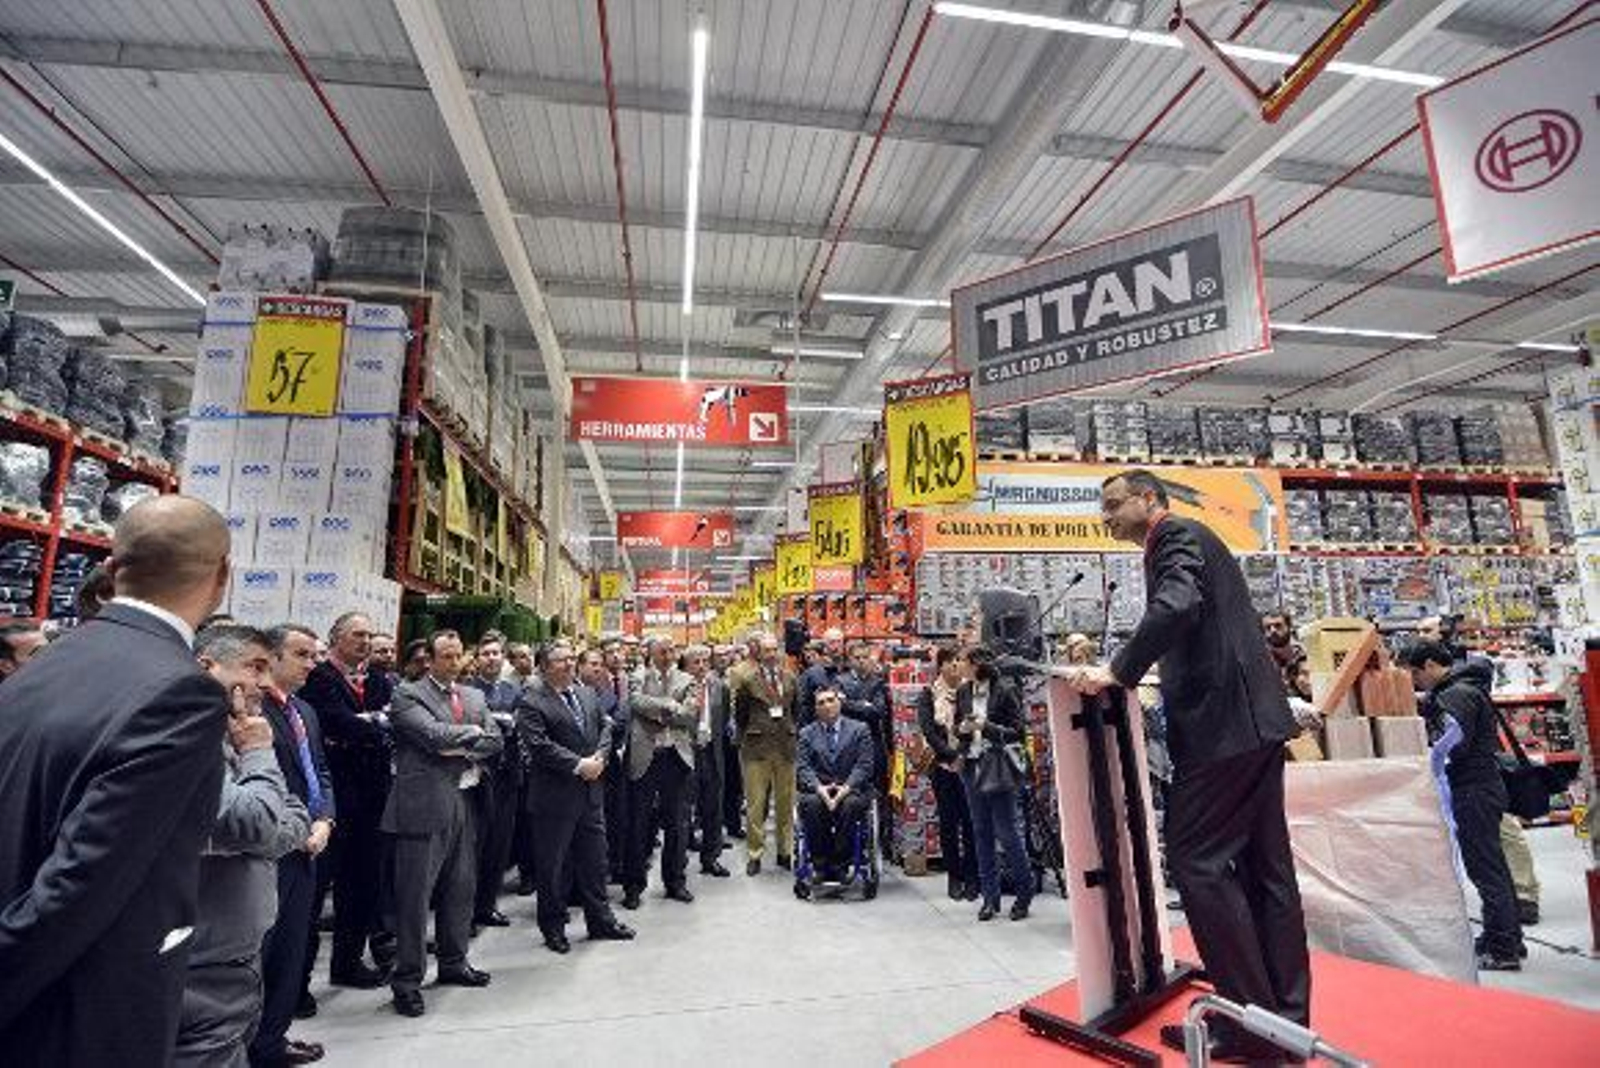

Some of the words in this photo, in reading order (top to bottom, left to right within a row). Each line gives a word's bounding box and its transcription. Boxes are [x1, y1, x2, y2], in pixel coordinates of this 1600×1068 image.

[984, 251, 1193, 350] TITAN
[986, 351, 1069, 381] CALIDAD
[1077, 344, 1089, 361] Y
[1097, 312, 1219, 355] ROBUSTEZ
[580, 421, 706, 439] HERRAMIENTAS
[1030, 522, 1051, 537] DE
[1055, 522, 1088, 537] POR
